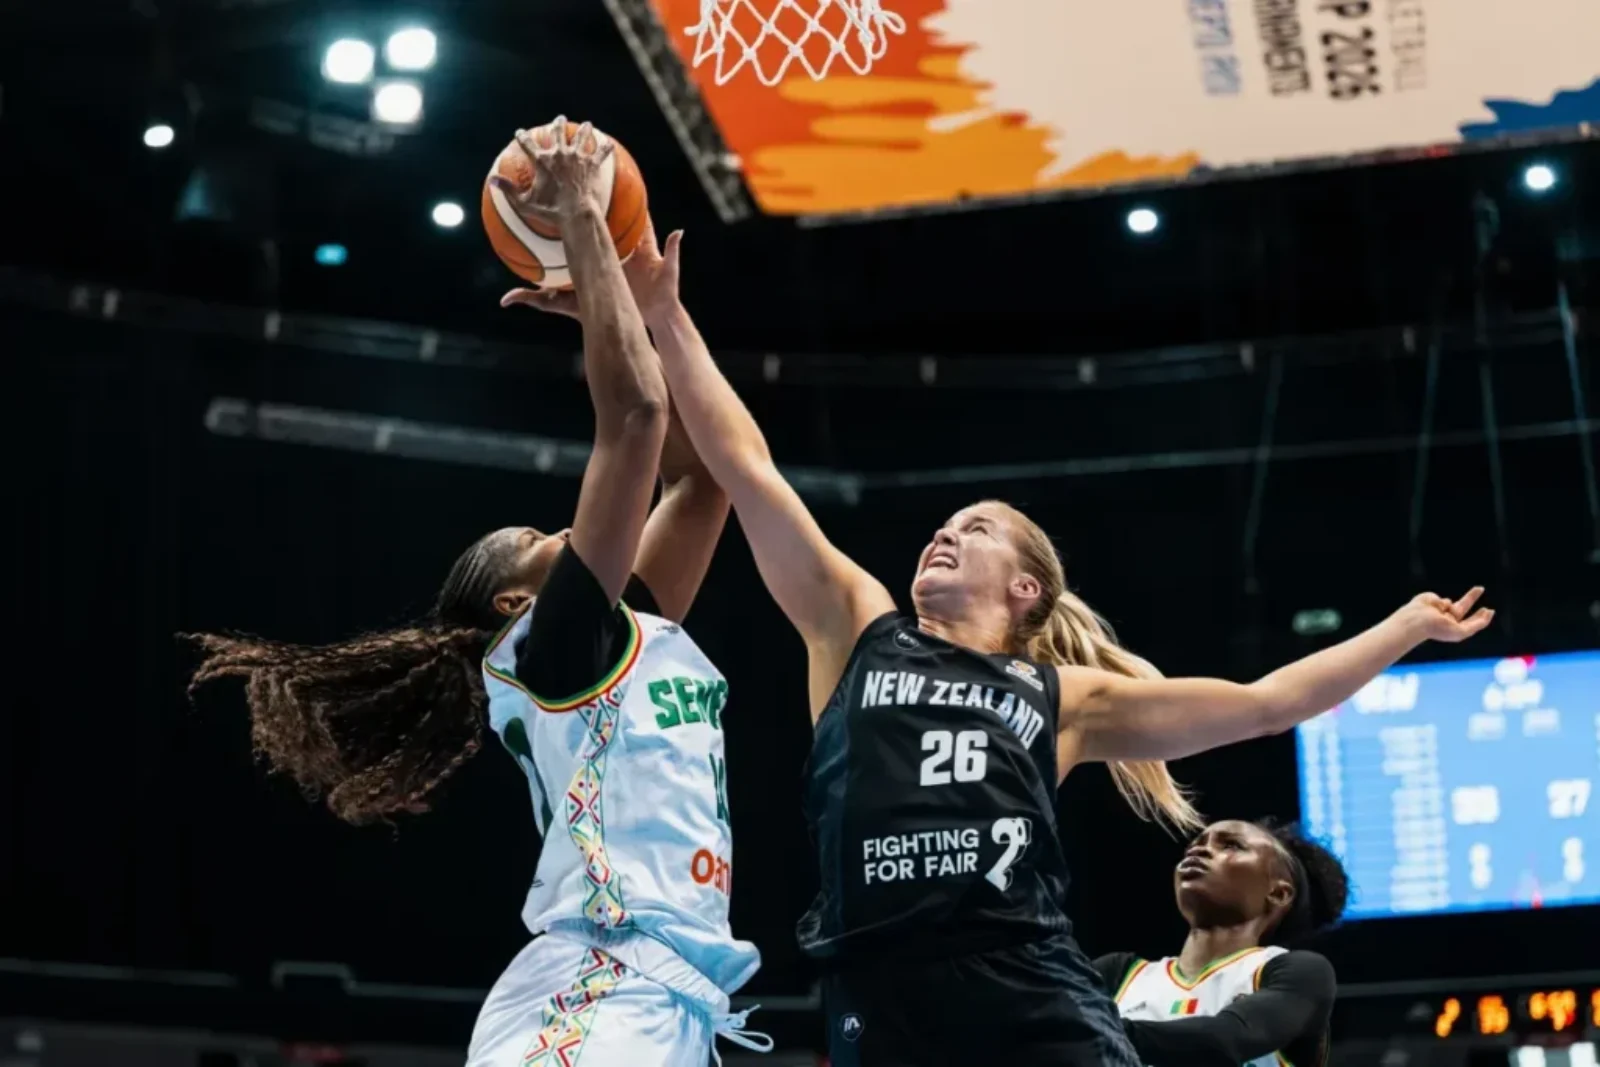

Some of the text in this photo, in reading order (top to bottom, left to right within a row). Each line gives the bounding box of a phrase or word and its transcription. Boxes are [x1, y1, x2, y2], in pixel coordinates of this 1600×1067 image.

[861, 671, 1045, 751] NEW ZEALAND
[919, 729, 989, 787] 26
[862, 828, 981, 860] FIGHTING
[864, 851, 979, 885] FOR FAIR
